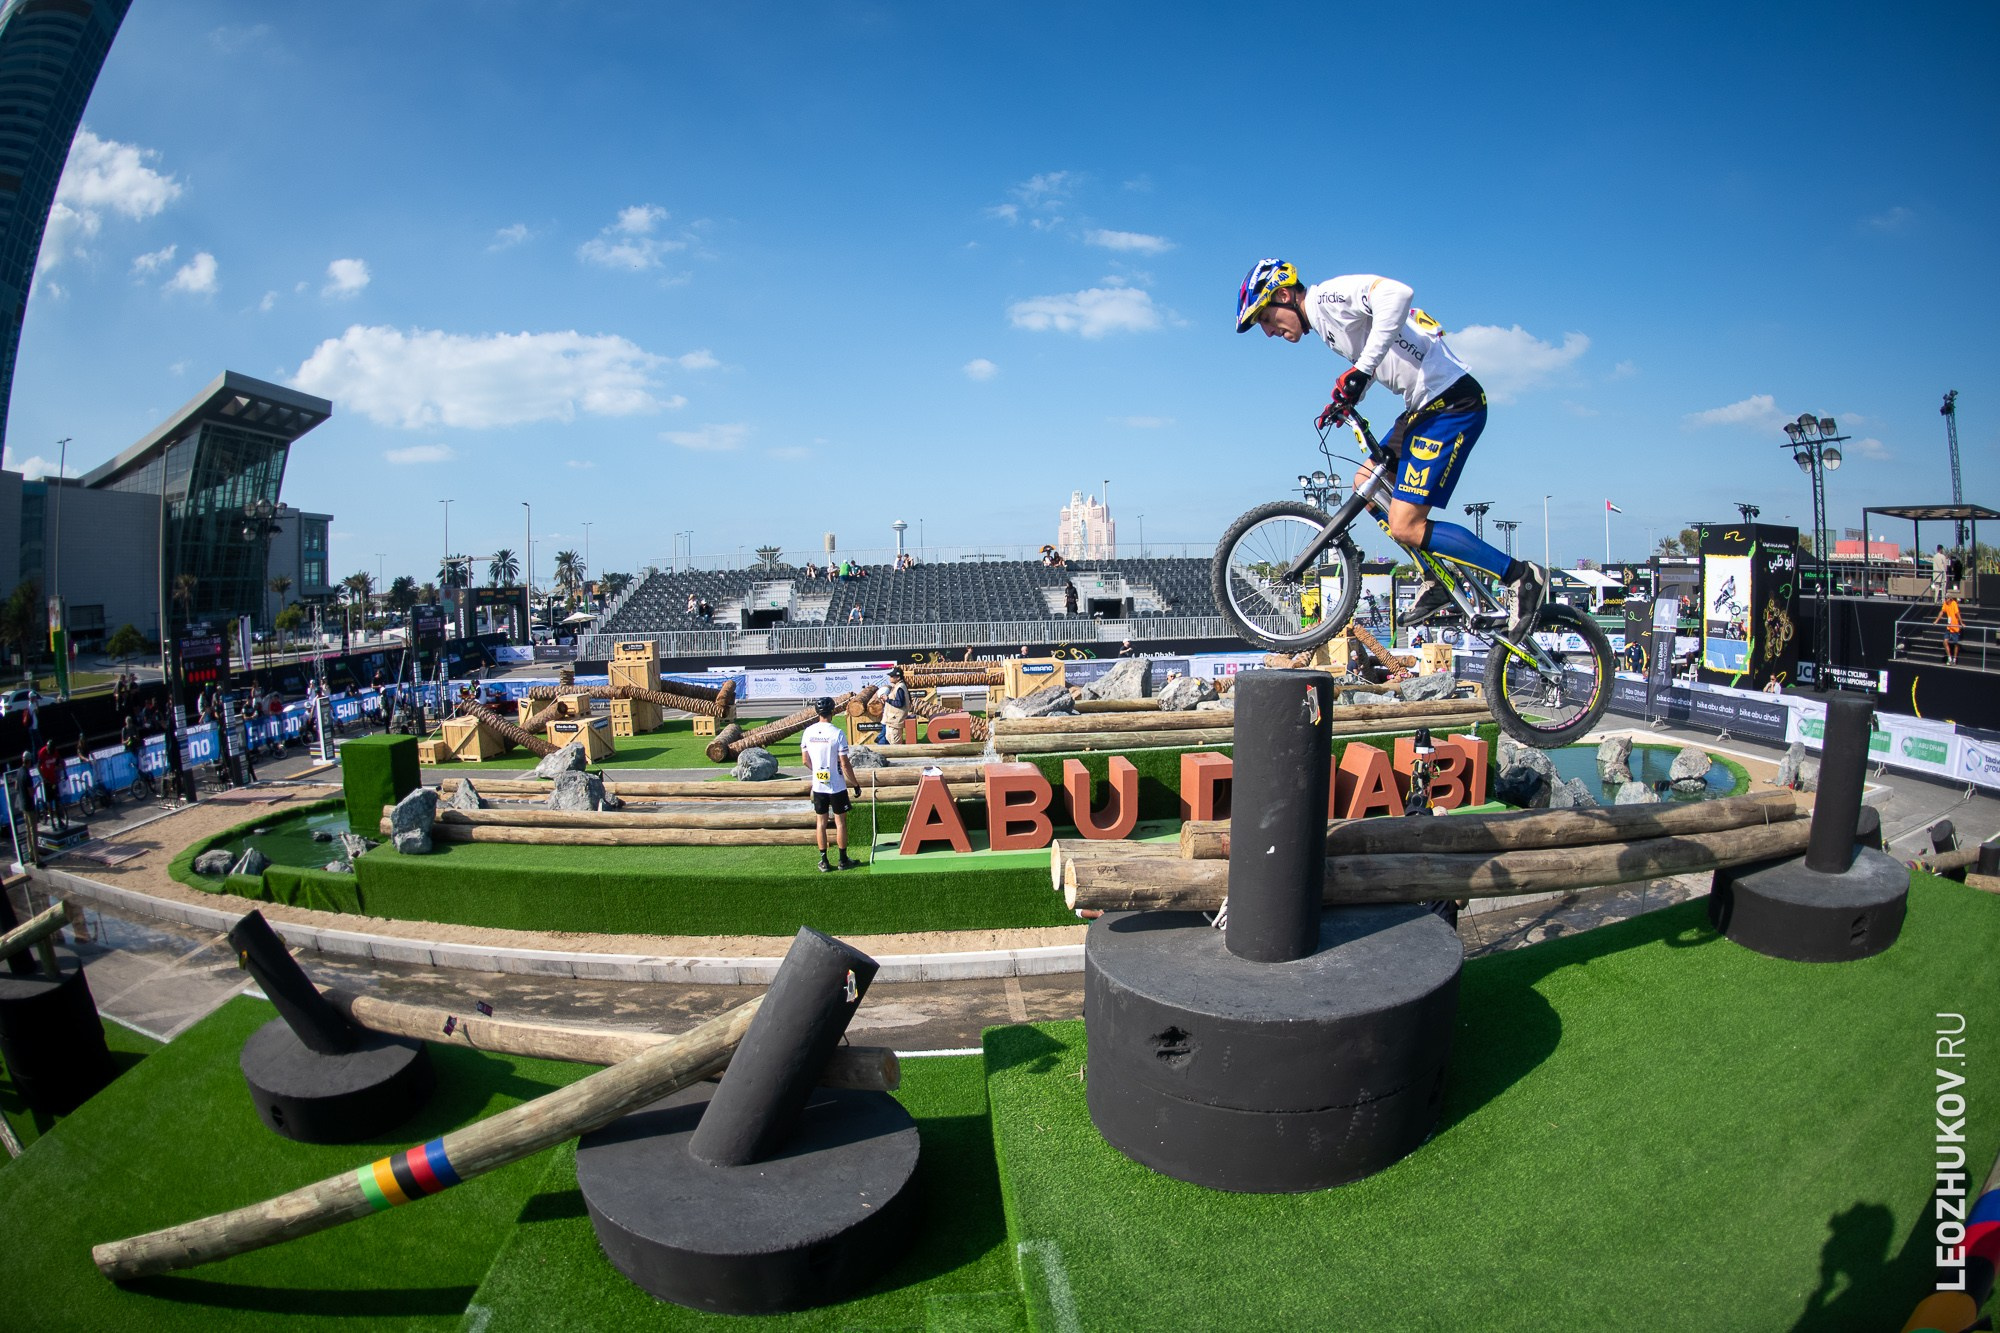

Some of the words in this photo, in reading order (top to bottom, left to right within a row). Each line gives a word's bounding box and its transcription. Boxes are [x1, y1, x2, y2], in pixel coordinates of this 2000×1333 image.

[1413, 438, 1440, 454] WD-40
[1398, 483, 1431, 497] COMAS
[1660, 603, 1671, 621] 4
[1847, 670, 1869, 679] CYCLING
[825, 681, 853, 693] 360
[1837, 676, 1877, 688] CHAMPIONSHIPS
[1634, 689, 1647, 697] Dhabi
[1656, 693, 1667, 702] bike
[1696, 700, 1708, 710] bike
[1708, 703, 1718, 712] abu
[1719, 703, 1735, 714] dhabi
[1739, 708, 1751, 717] bike
[1751, 711, 1762, 720] abu
[1763, 712, 1780, 723] dhabi
[1918, 742, 1929, 750] ABU
[1929, 744, 1946, 752] DHABI
[816, 772, 829, 780] 124
[900, 755, 1139, 856] ABU
